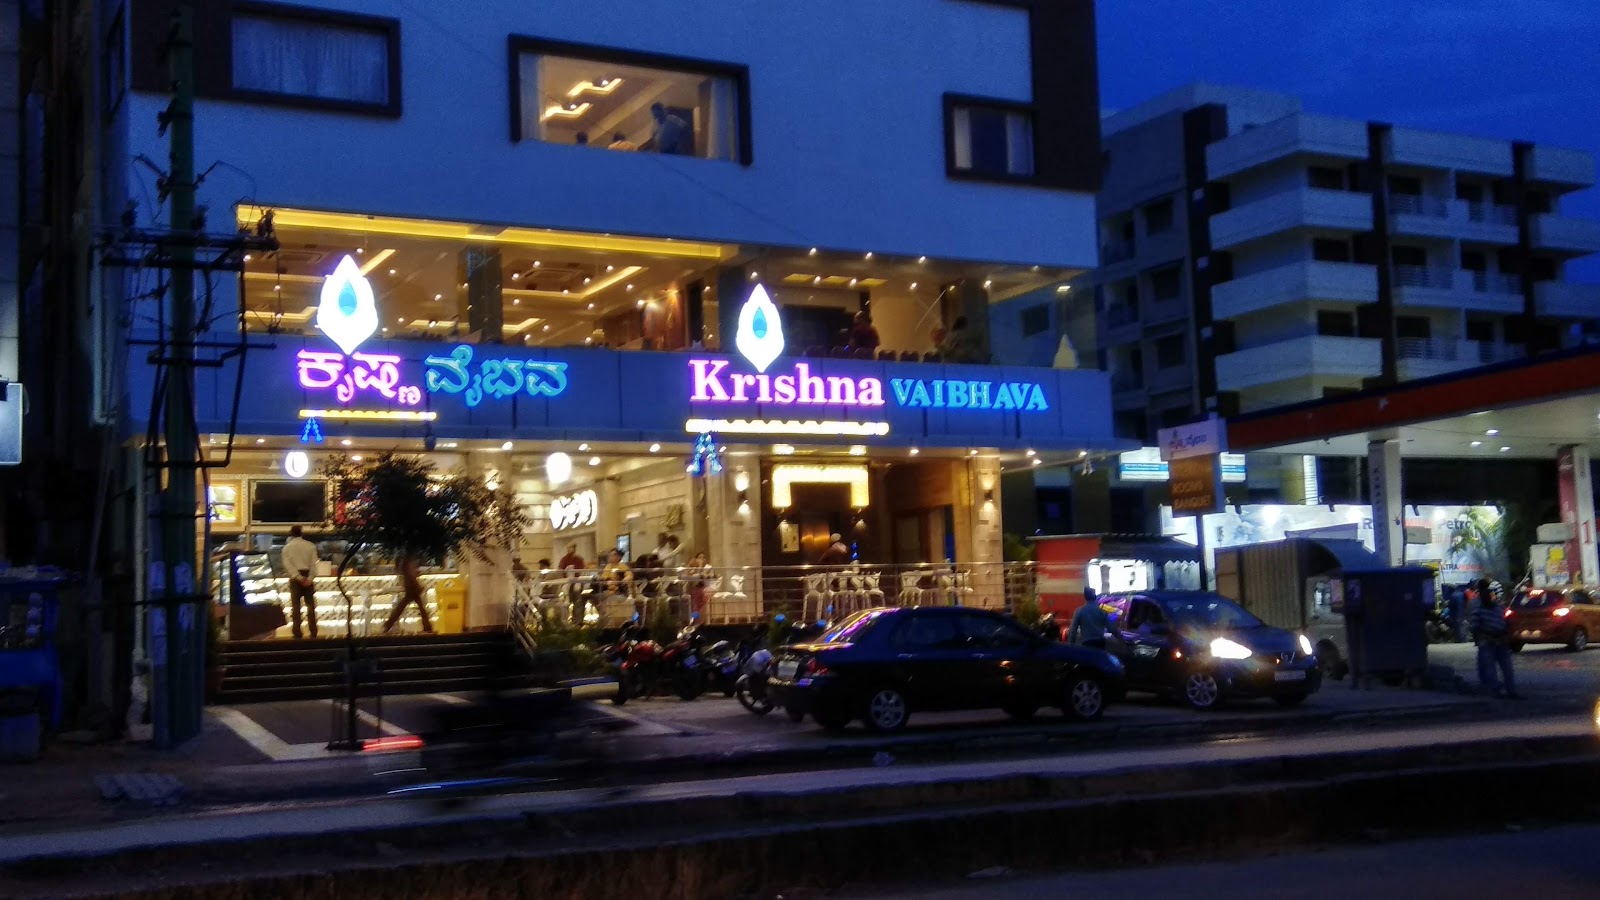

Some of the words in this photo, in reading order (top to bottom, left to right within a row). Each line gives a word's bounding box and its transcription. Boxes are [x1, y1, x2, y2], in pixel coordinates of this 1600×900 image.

[297, 349, 421, 405] ಕೃಷ್ಣ
[424, 344, 568, 407] ವೈಭವ
[688, 358, 885, 406] Krishna
[890, 378, 1049, 411] VAIBHAVA
